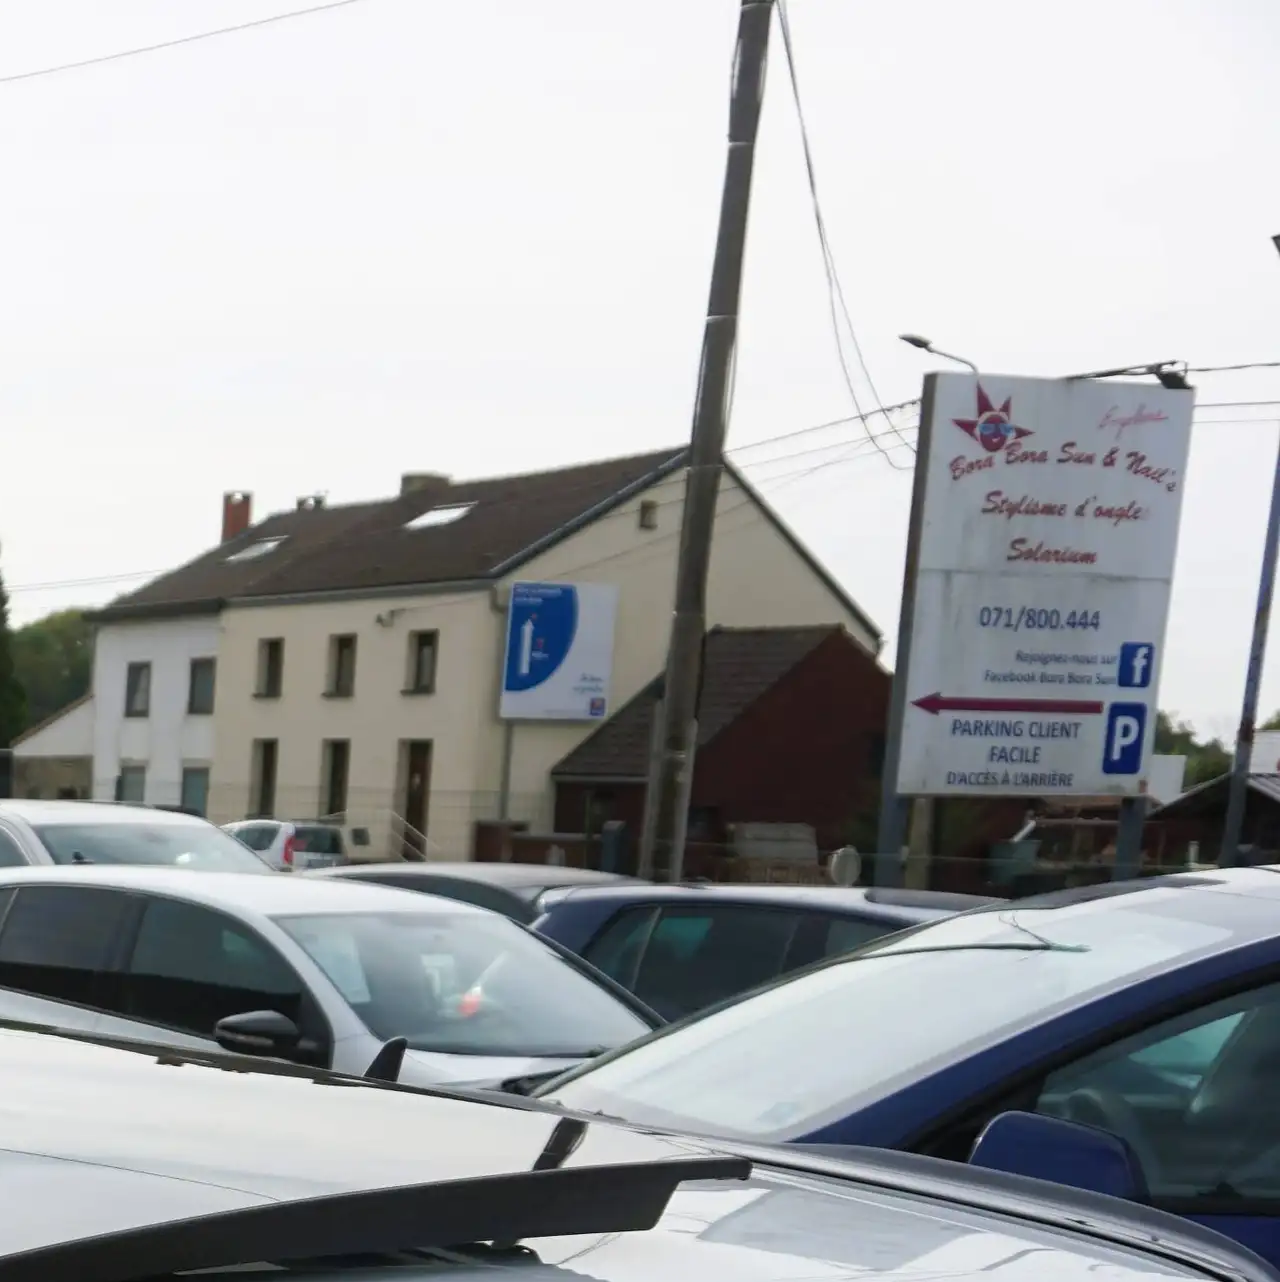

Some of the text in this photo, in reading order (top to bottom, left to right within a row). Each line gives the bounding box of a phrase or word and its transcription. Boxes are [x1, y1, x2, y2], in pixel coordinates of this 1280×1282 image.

[949, 454, 996, 480] Bora
[1005, 442, 1049, 465] Bora
[1057, 441, 1096, 465] Sun
[1102, 447, 1120, 467] &
[981, 490, 1067, 520] Stylisme
[1006, 537, 1098, 565] Solarium
[978, 606, 1101, 632] 071/800.444
[984, 669, 1038, 683] Facebook
[951, 718, 1082, 739] PARKING CLIENT
[1111, 715, 1139, 761] P
[988, 746, 1042, 764] FACILE
